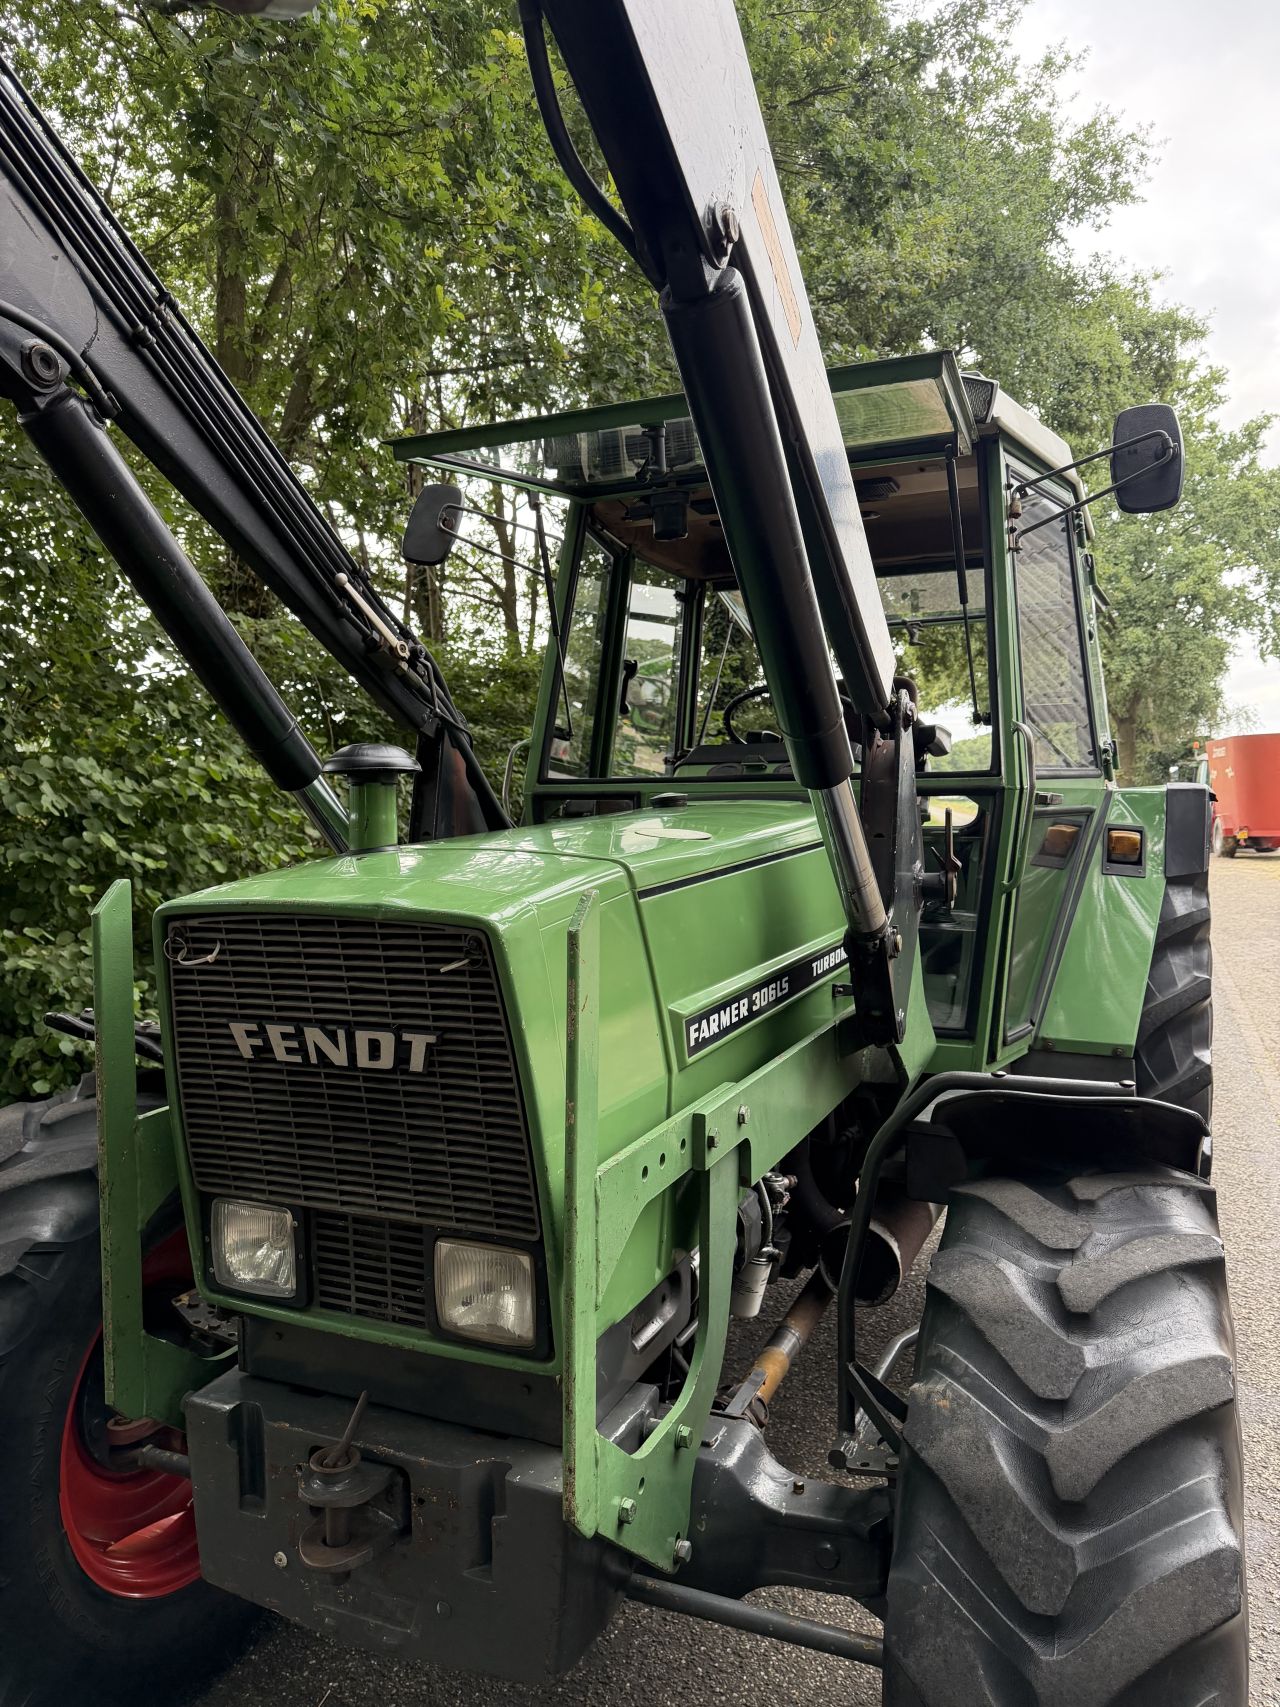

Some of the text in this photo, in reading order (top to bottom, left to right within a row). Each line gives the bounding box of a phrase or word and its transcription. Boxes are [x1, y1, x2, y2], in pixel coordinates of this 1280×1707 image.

[689, 998, 749, 1047] FARMER
[752, 976, 789, 1012] 306LS
[228, 1021, 440, 1073] FENDT
